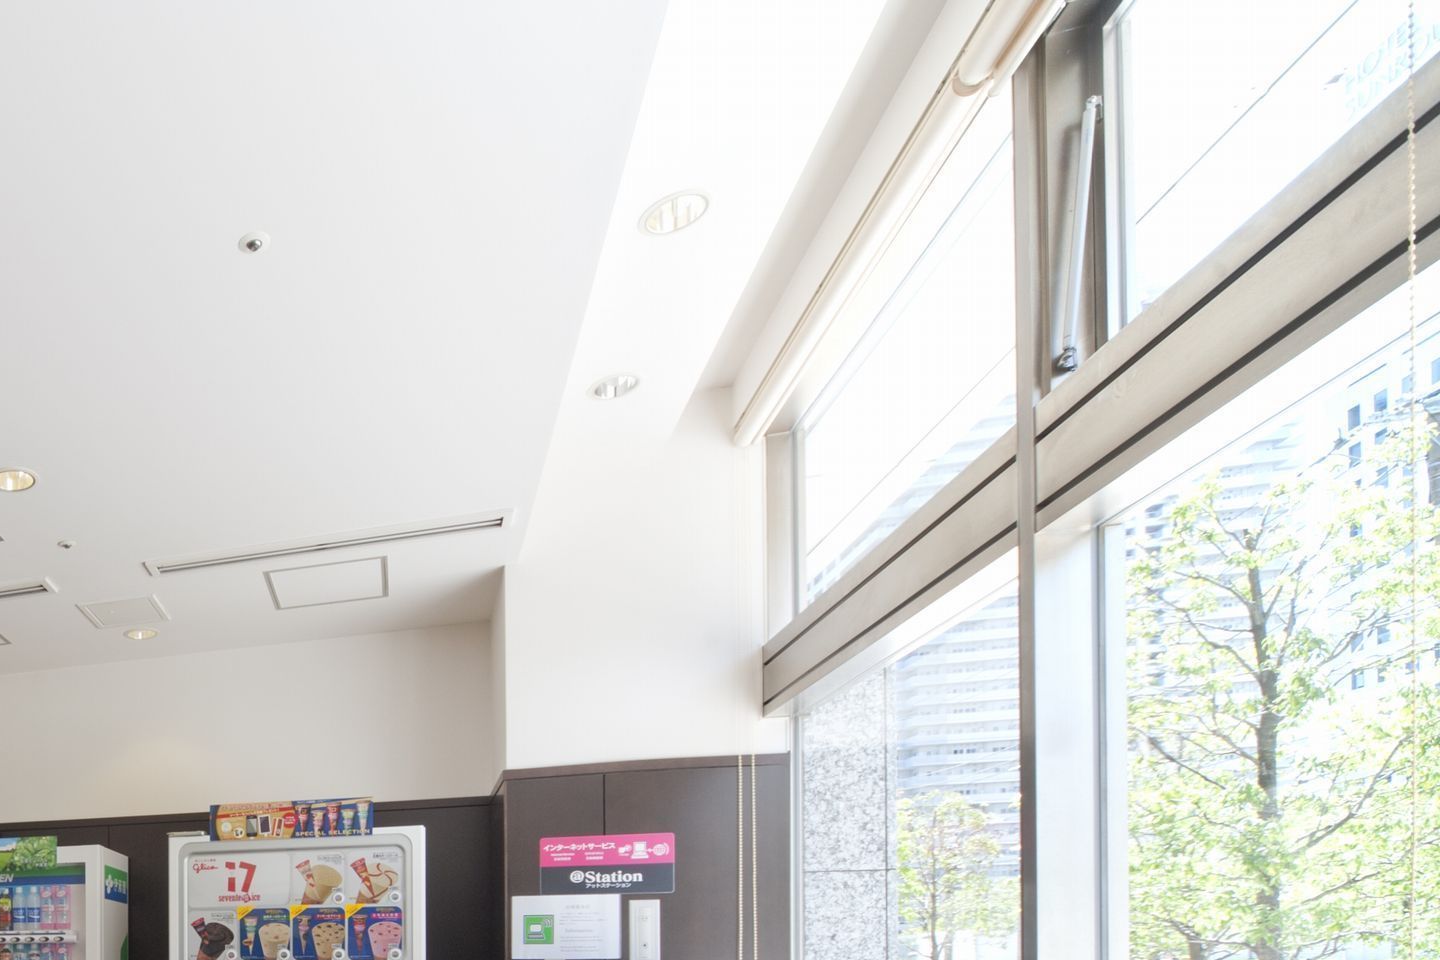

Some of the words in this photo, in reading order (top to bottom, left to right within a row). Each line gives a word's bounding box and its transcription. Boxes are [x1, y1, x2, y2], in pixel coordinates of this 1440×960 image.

[543, 842, 616, 852] インターネットサービス
[569, 870, 643, 884] @Station
